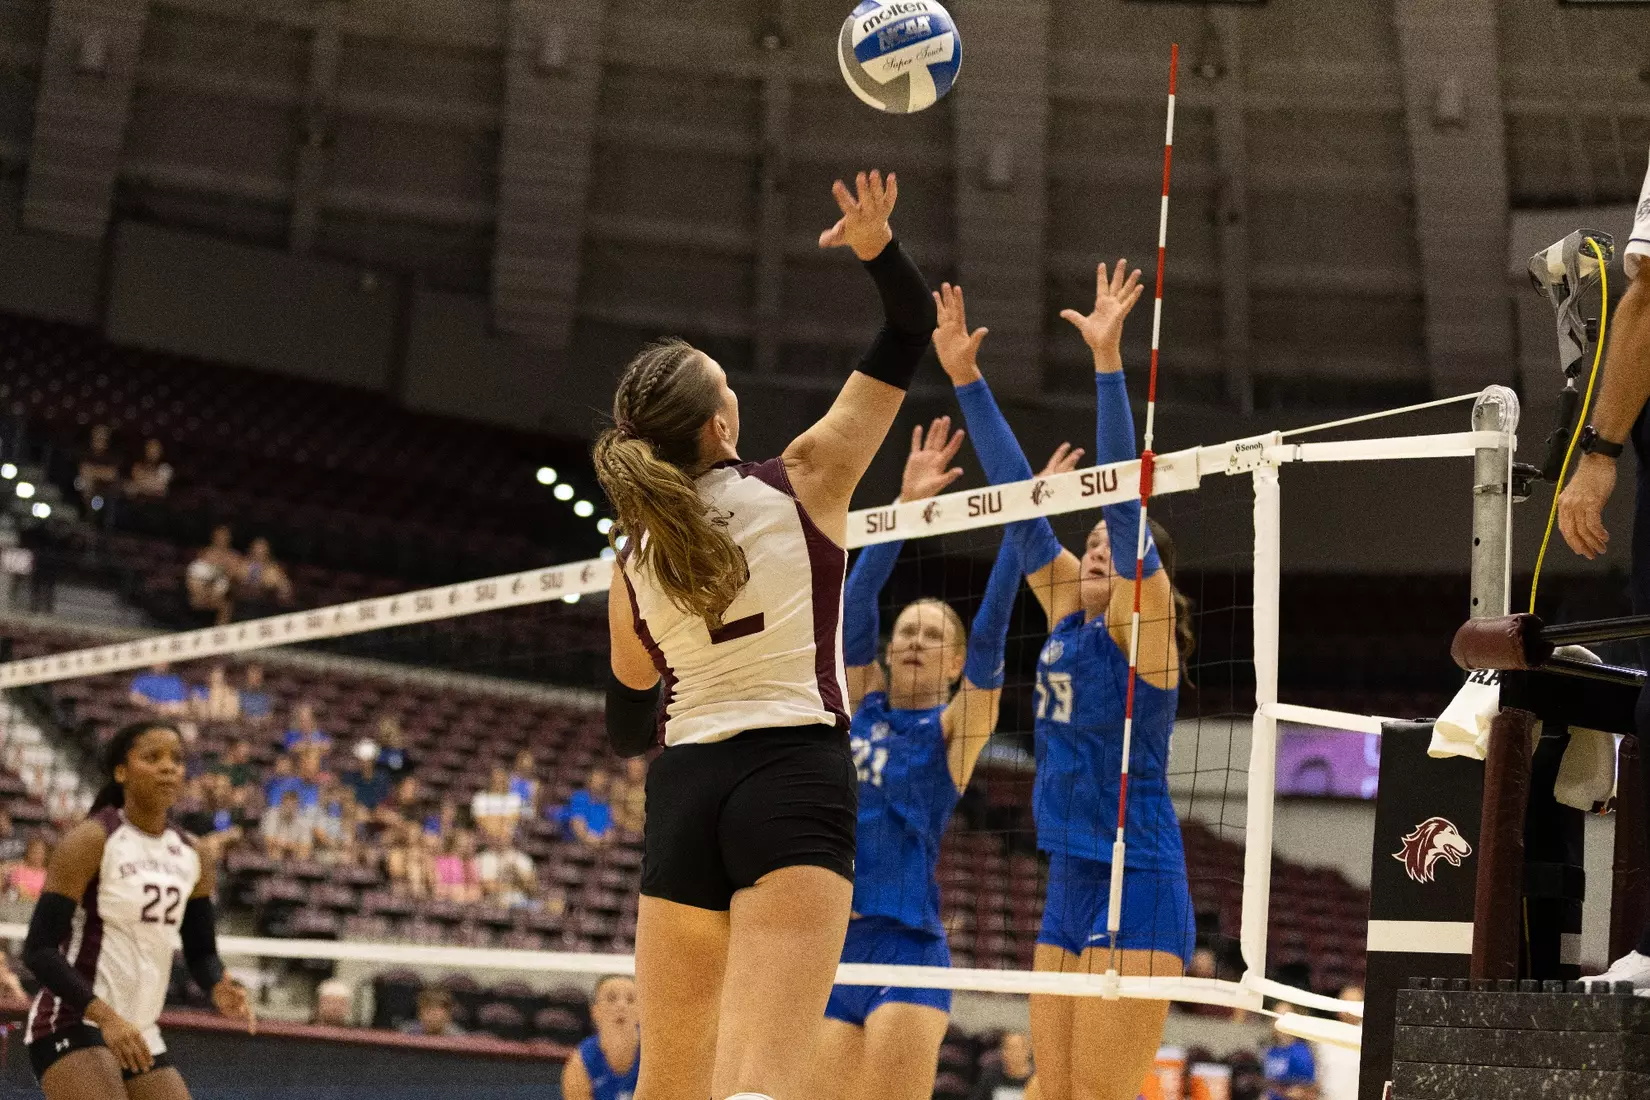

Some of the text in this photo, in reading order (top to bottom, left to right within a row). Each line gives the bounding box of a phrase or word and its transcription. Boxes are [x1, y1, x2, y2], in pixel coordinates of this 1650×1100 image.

[862, 2, 928, 33] molten
[877, 15, 932, 50] NCAA
[883, 56, 912, 71] Super
[1240, 441, 1264, 452] Senoh
[866, 469, 1118, 534] SIU SIU SIU
[141, 884, 180, 925] 22
